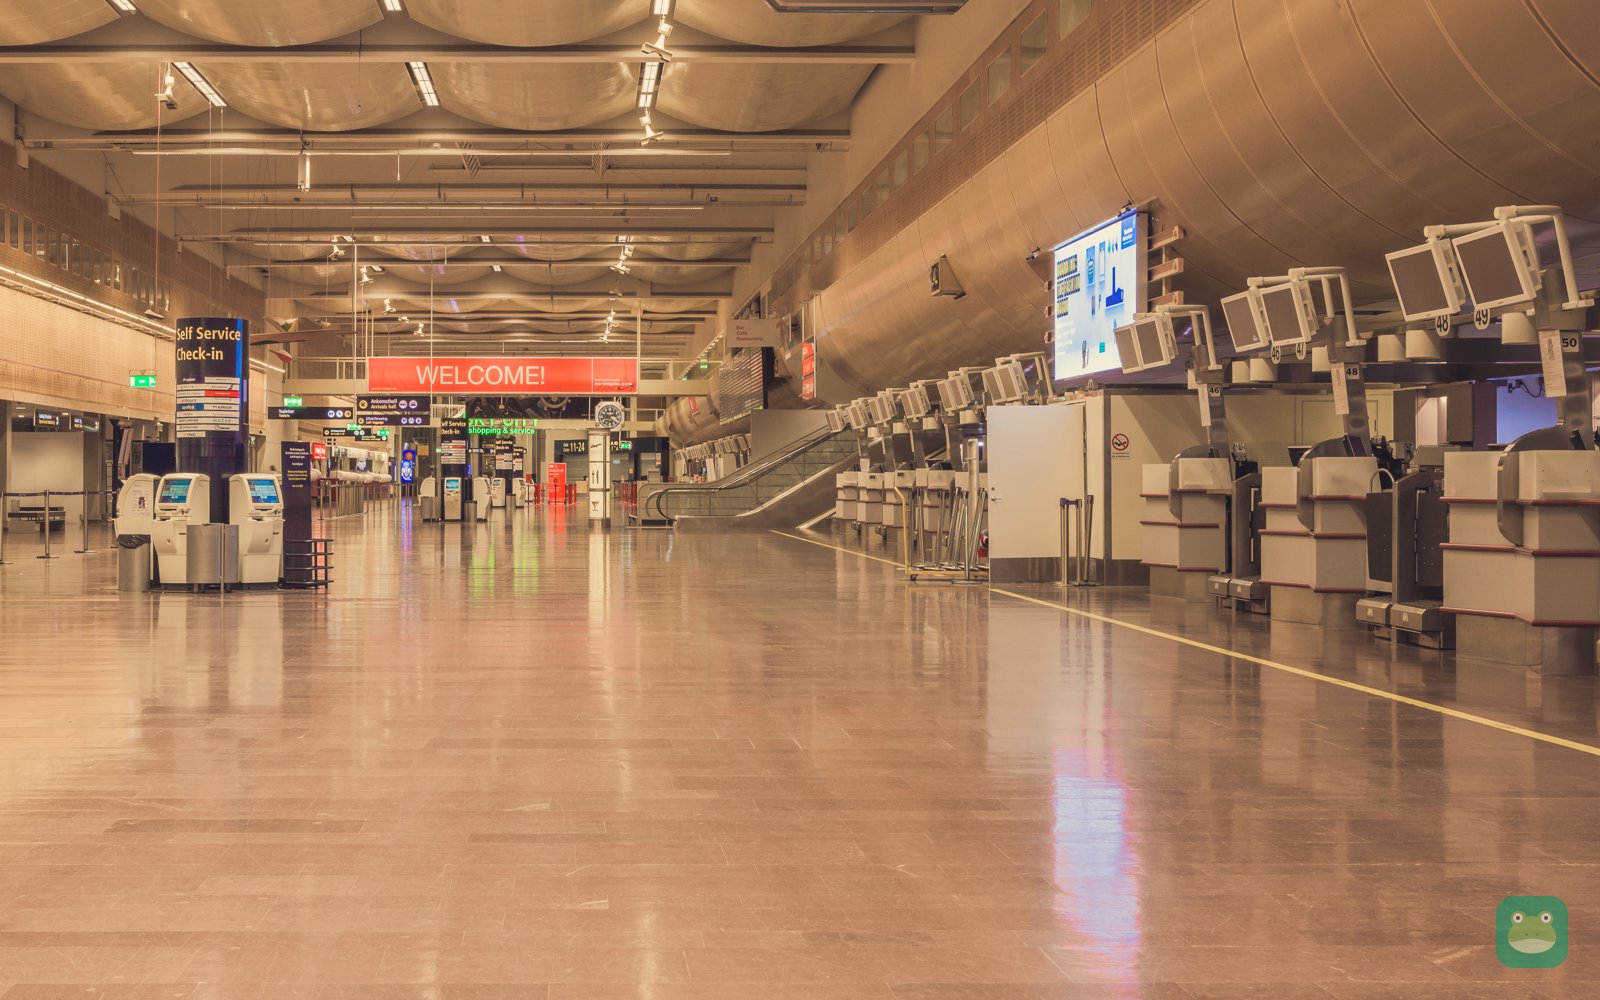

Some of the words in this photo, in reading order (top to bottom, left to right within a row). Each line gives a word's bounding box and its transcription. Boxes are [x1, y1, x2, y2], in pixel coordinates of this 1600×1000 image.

[1436, 314, 1449, 332] 48
[1475, 309, 1488, 326] 49
[177, 327, 193, 340] Self
[196, 327, 241, 340] Service
[1561, 337, 1577, 348] 50
[177, 347, 224, 361] Check-in
[415, 365, 546, 386] WELCOME!
[1345, 367, 1358, 377] 48
[1209, 386, 1220, 394] 46
[468, 427, 501, 435] shopping
